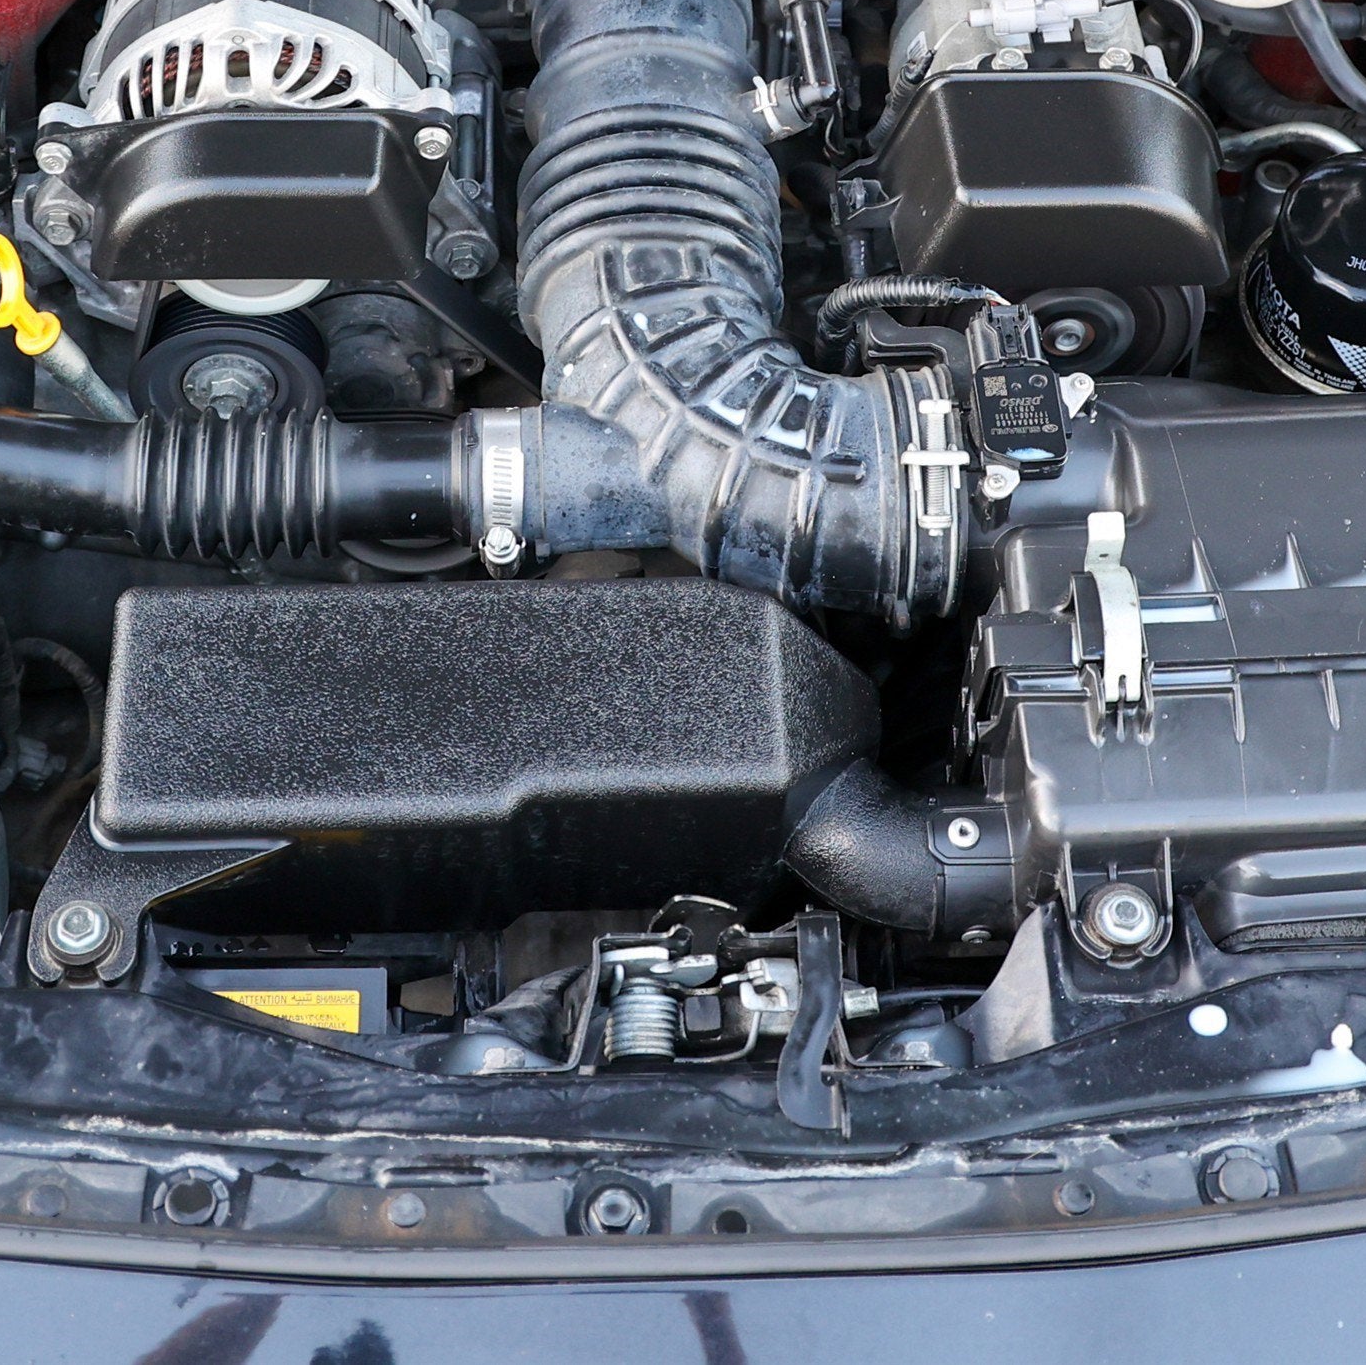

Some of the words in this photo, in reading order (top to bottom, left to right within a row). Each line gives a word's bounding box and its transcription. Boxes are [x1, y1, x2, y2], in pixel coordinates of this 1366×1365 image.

[999, 395, 1044, 407] DENSO
[239, 995, 287, 1005] ATTENTION
[315, 994, 356, 1004] ВНИМАНИЕ
